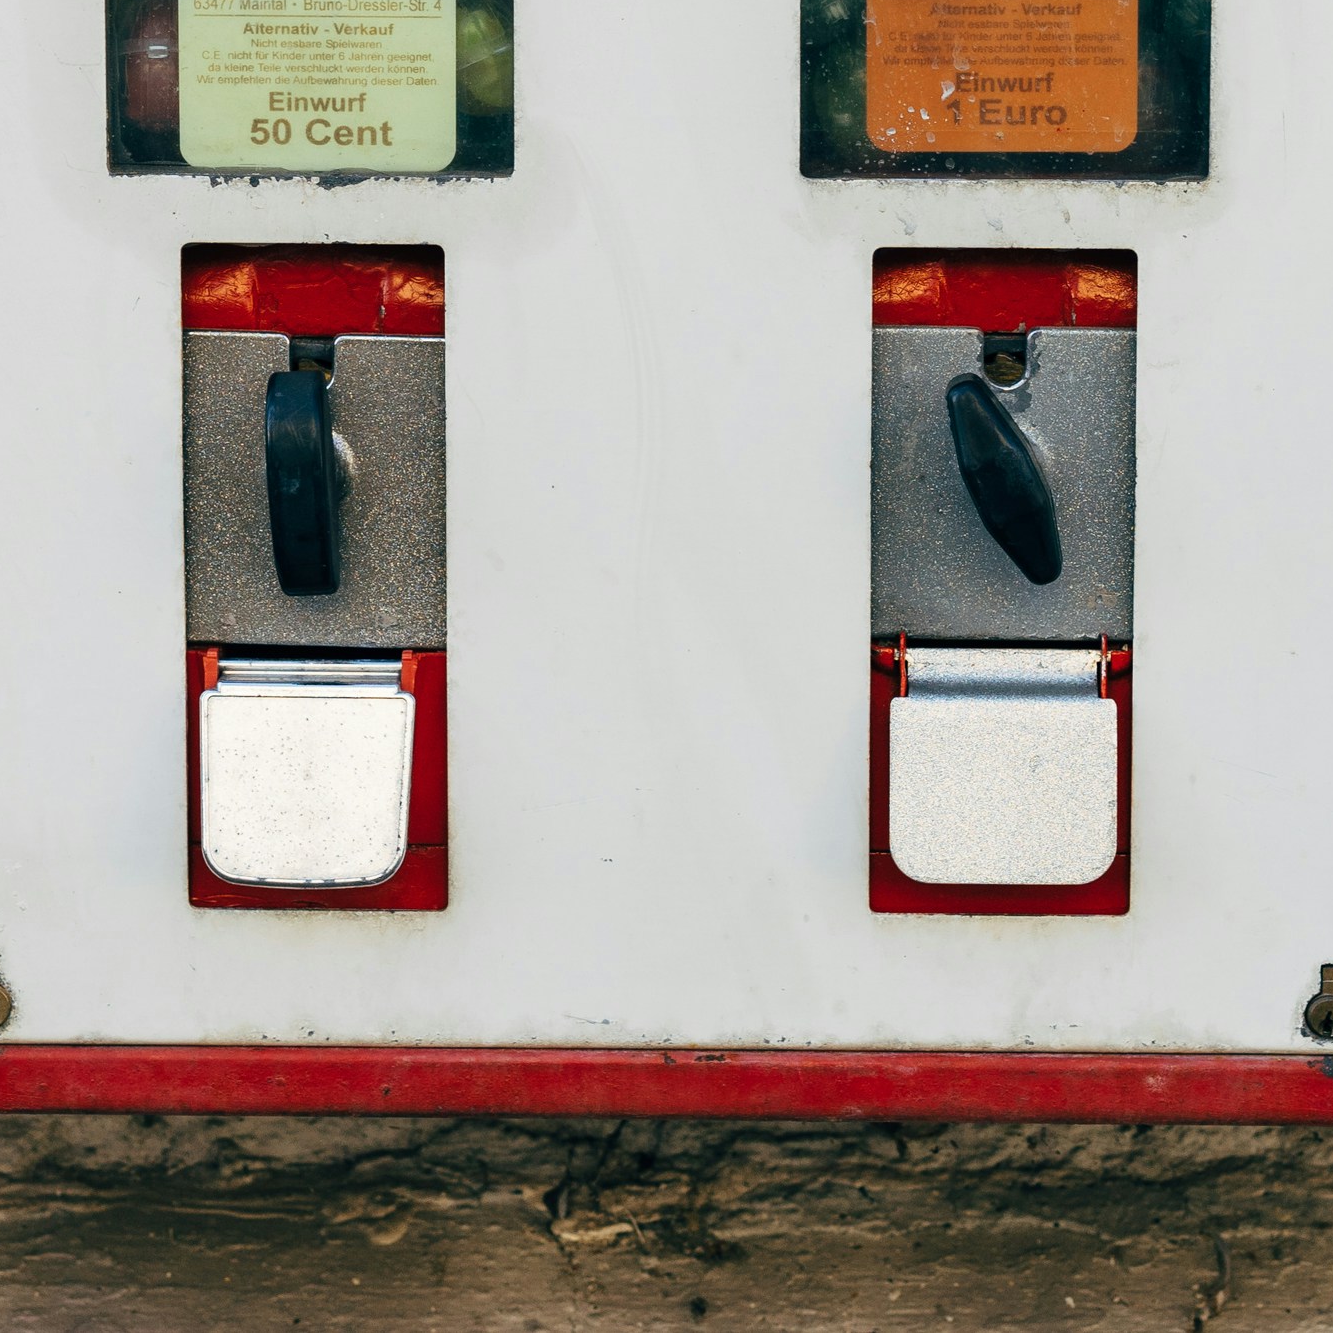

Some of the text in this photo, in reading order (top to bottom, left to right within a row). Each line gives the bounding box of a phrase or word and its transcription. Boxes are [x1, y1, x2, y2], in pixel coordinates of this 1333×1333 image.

[1021, 3, 1082, 16] Verkauf
[243, 22, 395, 36] Alternativ Verkauf
[251, 39, 383, 50] Nicht essbare Spielwaren
[228, 51, 252, 60] nicht
[255, 51, 269, 60] für
[272, 51, 306, 60] Kinder
[309, 52, 335, 61] unter
[338, 51, 345, 61] 6
[348, 51, 384, 61] Jahren
[208, 63, 221, 72] da
[224, 63, 255, 72] kleine
[258, 63, 282, 72] Teile
[285, 63, 343, 73] verschluckt
[346, 64, 384, 73] werden
[197, 75, 214, 84] Wir
[217, 75, 272, 86] empfehlen
[274, 75, 291, 84] die
[293, 76, 368, 87] Aufbewahrung
[371, 76, 404, 86] dieser
[955, 72, 1055, 93] Einwurf
[268, 91, 367, 112] Einwurf
[946, 98, 1068, 126] 1 Euro
[250, 118, 393, 147] 50 Cent
